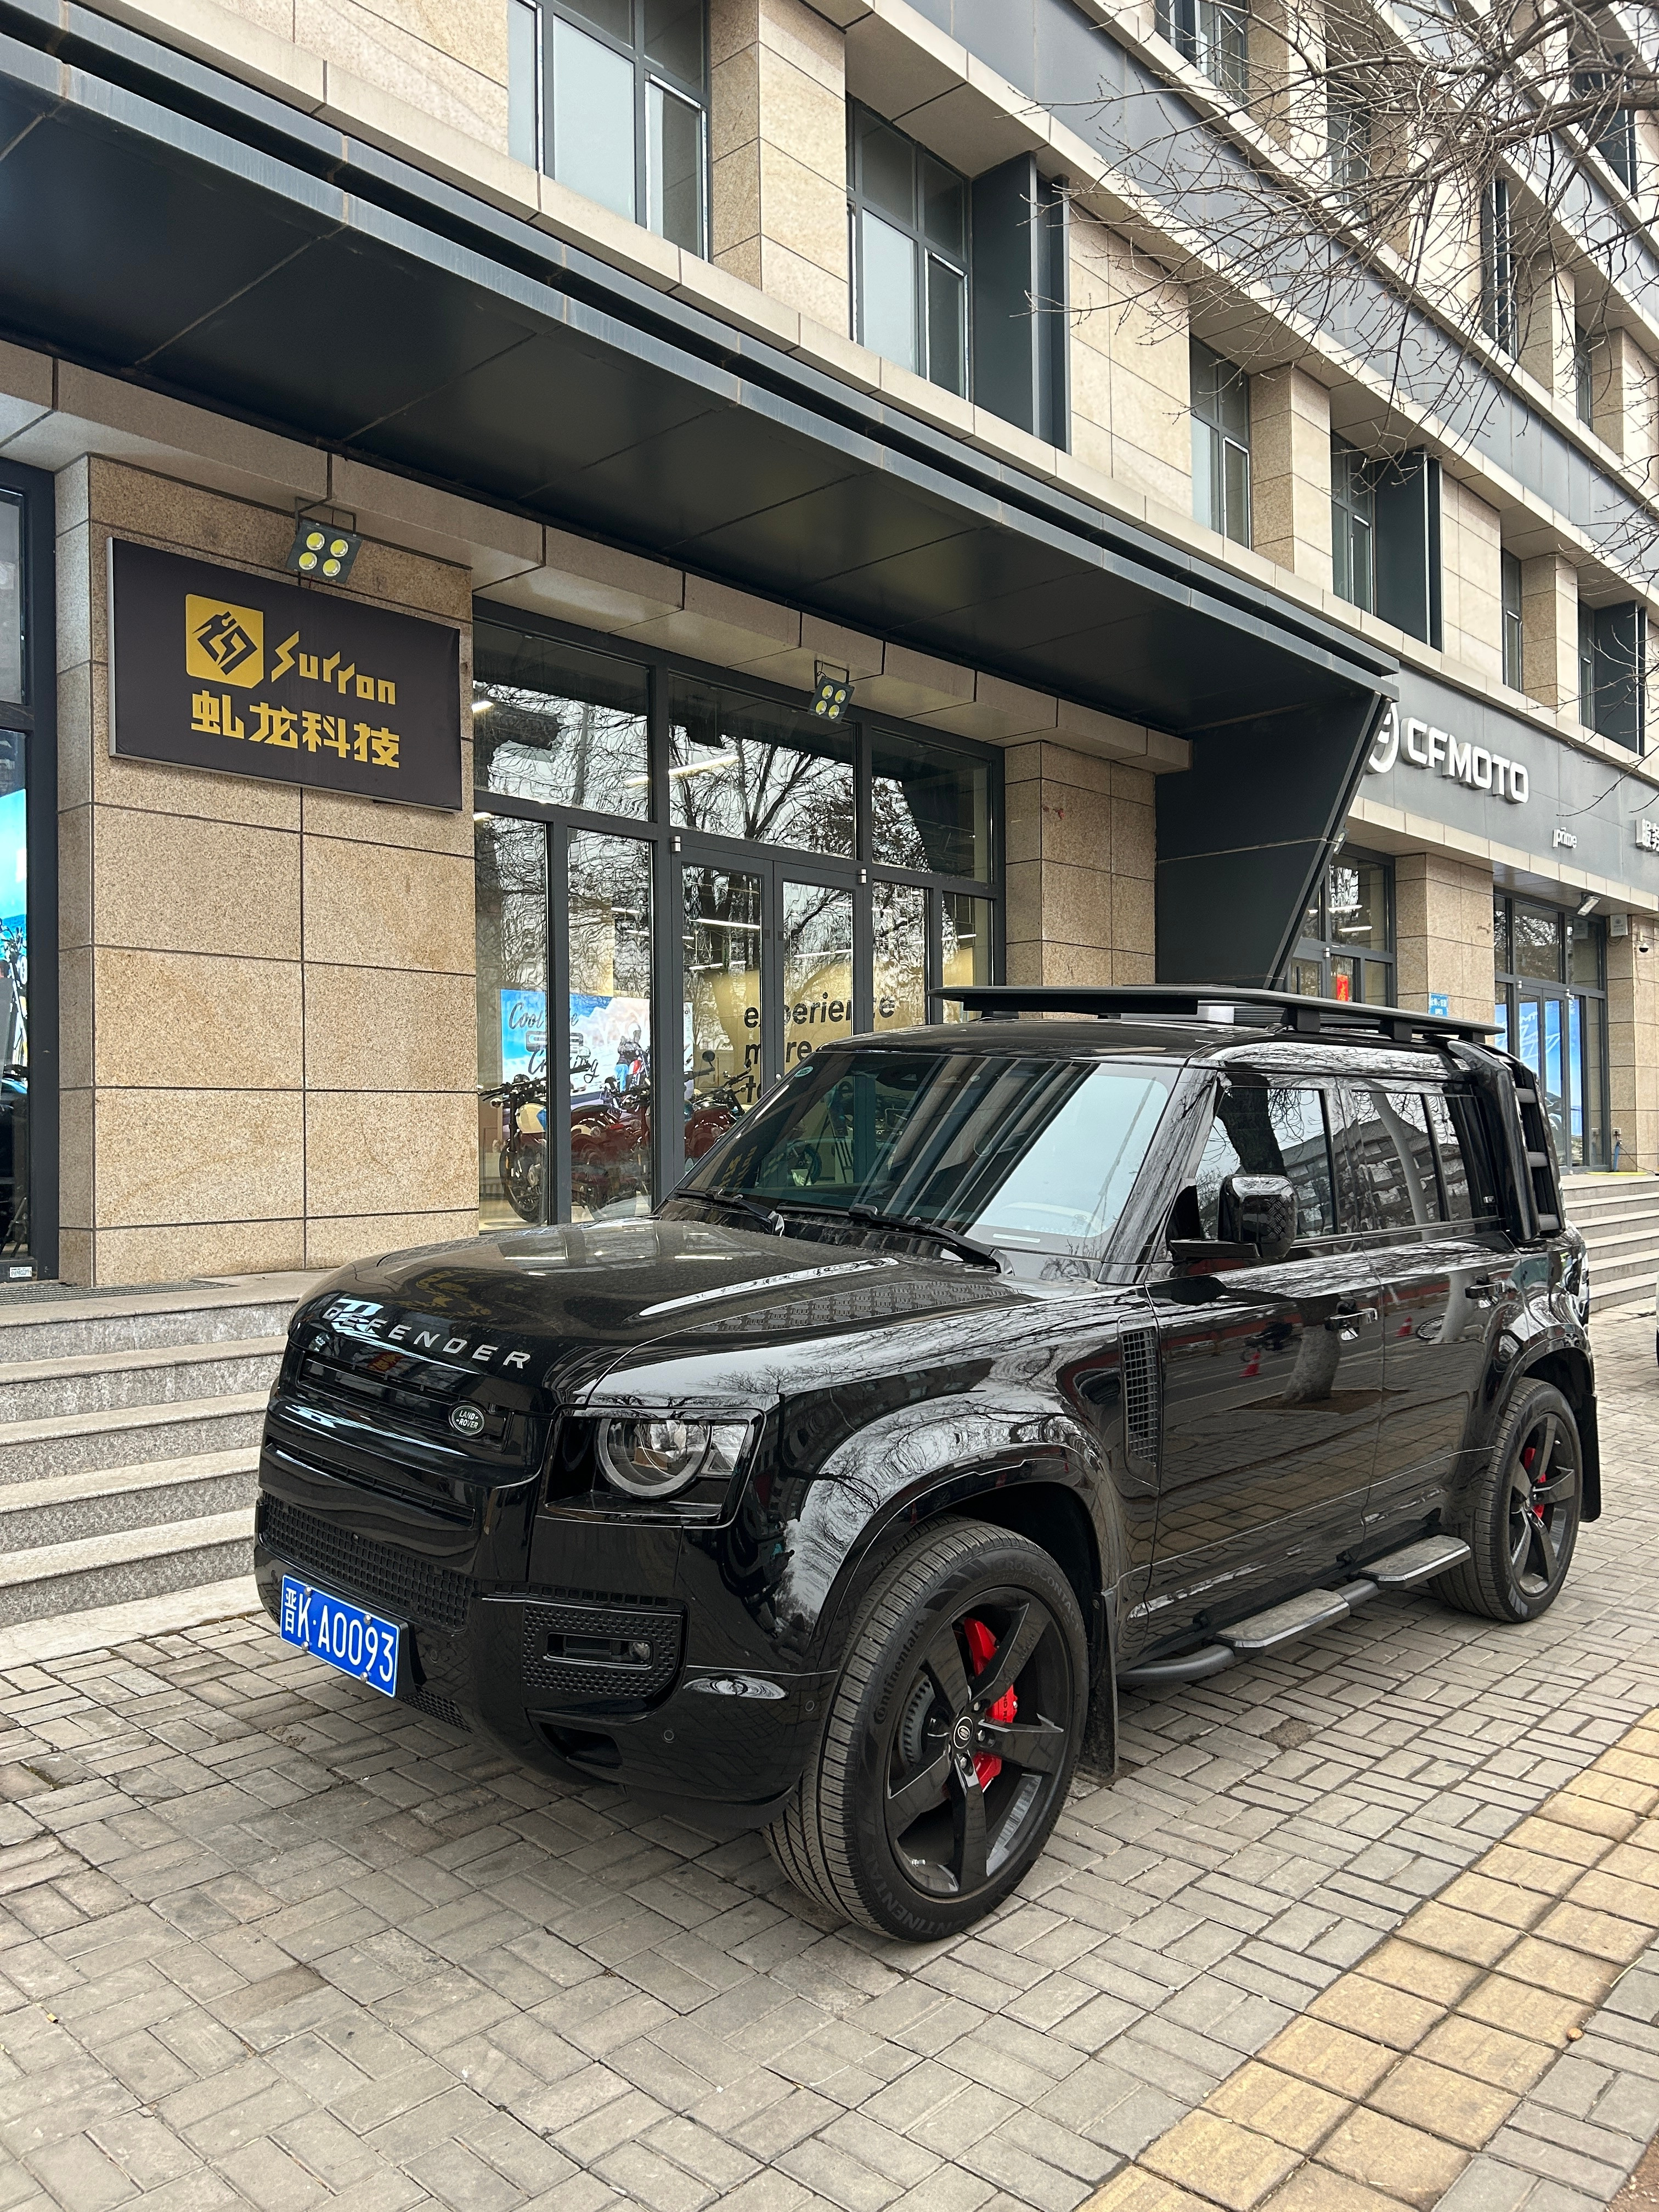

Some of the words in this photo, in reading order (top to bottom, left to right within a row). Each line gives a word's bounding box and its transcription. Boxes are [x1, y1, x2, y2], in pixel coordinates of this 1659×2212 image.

[190, 690, 400, 769] 虬龙科技
[1400, 716, 1529, 804] CFMOTO
[1553, 827, 1577, 849] prime
[509, 1002, 545, 1029] Cool
[745, 1040, 812, 1065] mre
[321, 1306, 532, 1369] DEFENDER
[458, 1418, 479, 1429] ROVER
[459, 1410, 476, 1420] LAND
